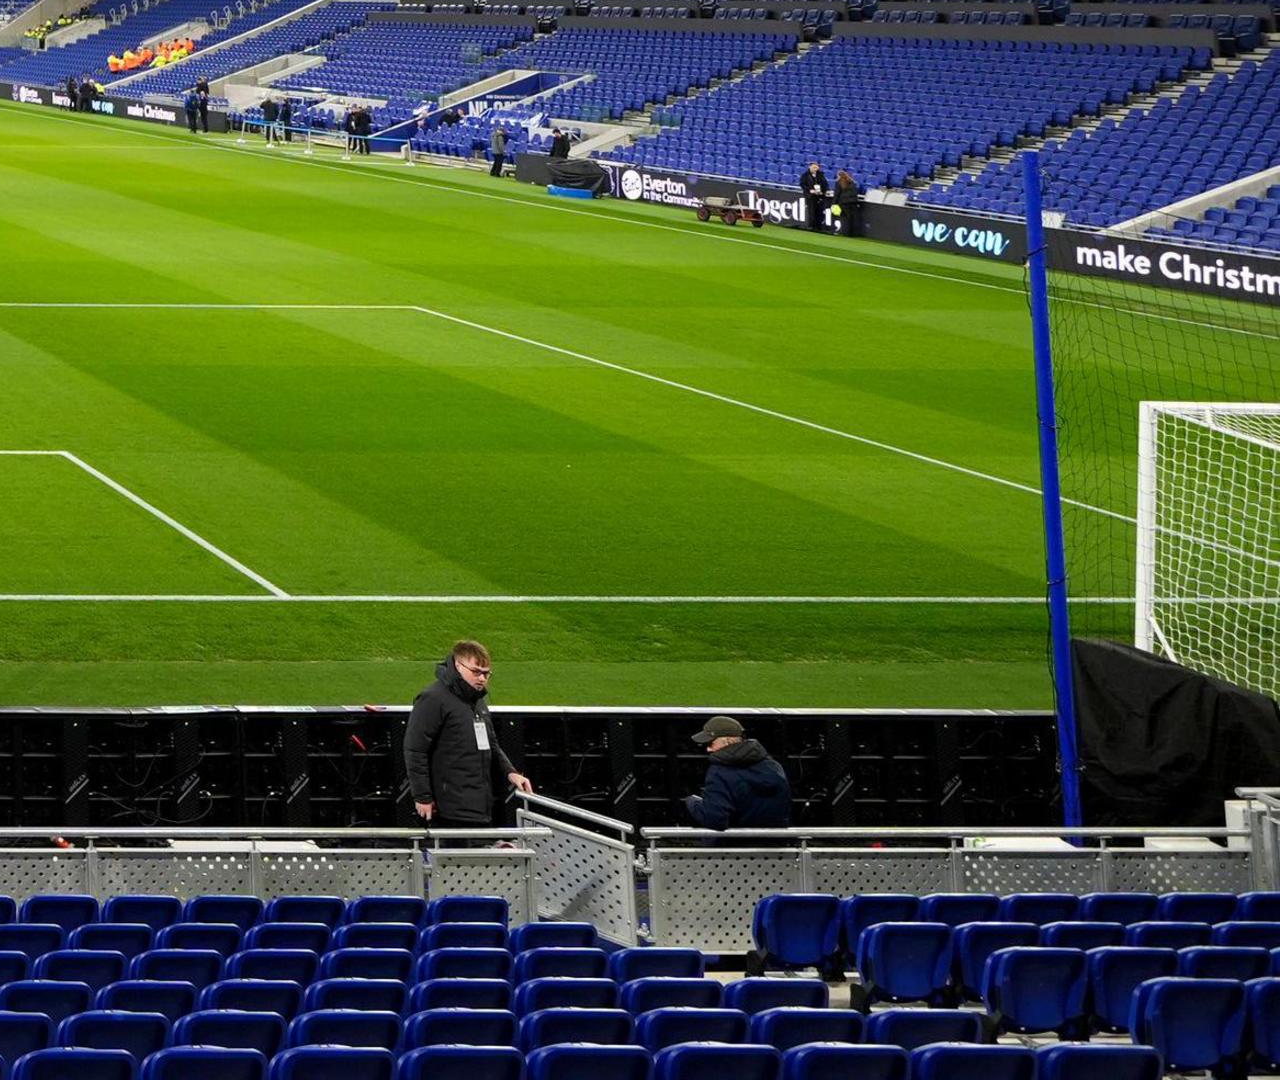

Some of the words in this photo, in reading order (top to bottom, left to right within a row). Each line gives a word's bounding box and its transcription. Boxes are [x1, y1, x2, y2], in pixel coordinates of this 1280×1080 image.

[642, 174, 686, 197] Everton
[911, 219, 953, 243] we
[953, 226, 1011, 256] can
[1076, 244, 1152, 276] make
